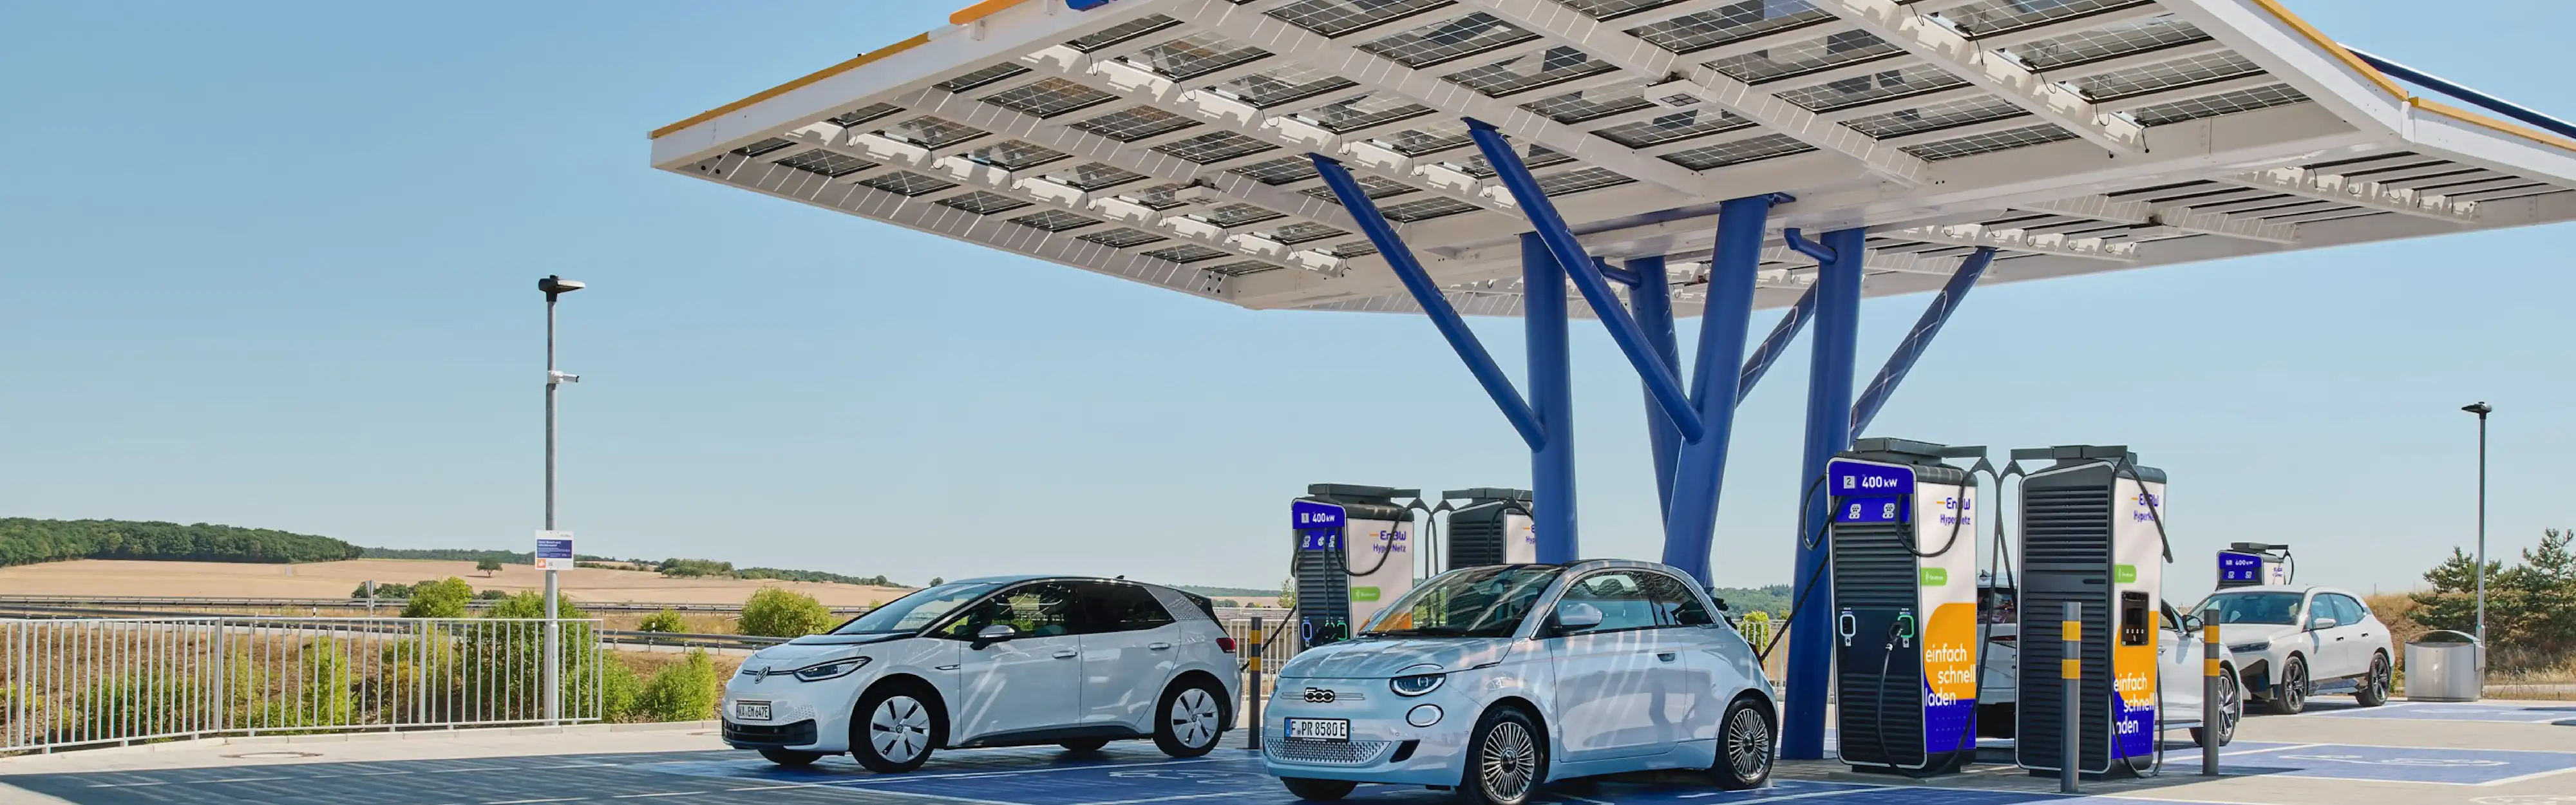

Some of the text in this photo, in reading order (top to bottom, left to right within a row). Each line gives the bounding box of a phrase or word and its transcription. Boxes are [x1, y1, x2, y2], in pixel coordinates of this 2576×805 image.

[1846, 477, 1898, 488] 2 400 kW
[1947, 498, 1970, 510] EnW
[1312, 513, 1325, 522] 400
[1926, 643, 1967, 663] einfach
[1938, 665, 1976, 684] schnell
[2114, 672, 2147, 692] einfach
[1304, 687, 1336, 703] 500
[1925, 687, 1956, 707] laden
[2124, 692, 2155, 713] schnell
[1291, 721, 1296, 735] F
[1302, 722, 1312, 735] PR
[1315, 722, 1338, 736] 8580
